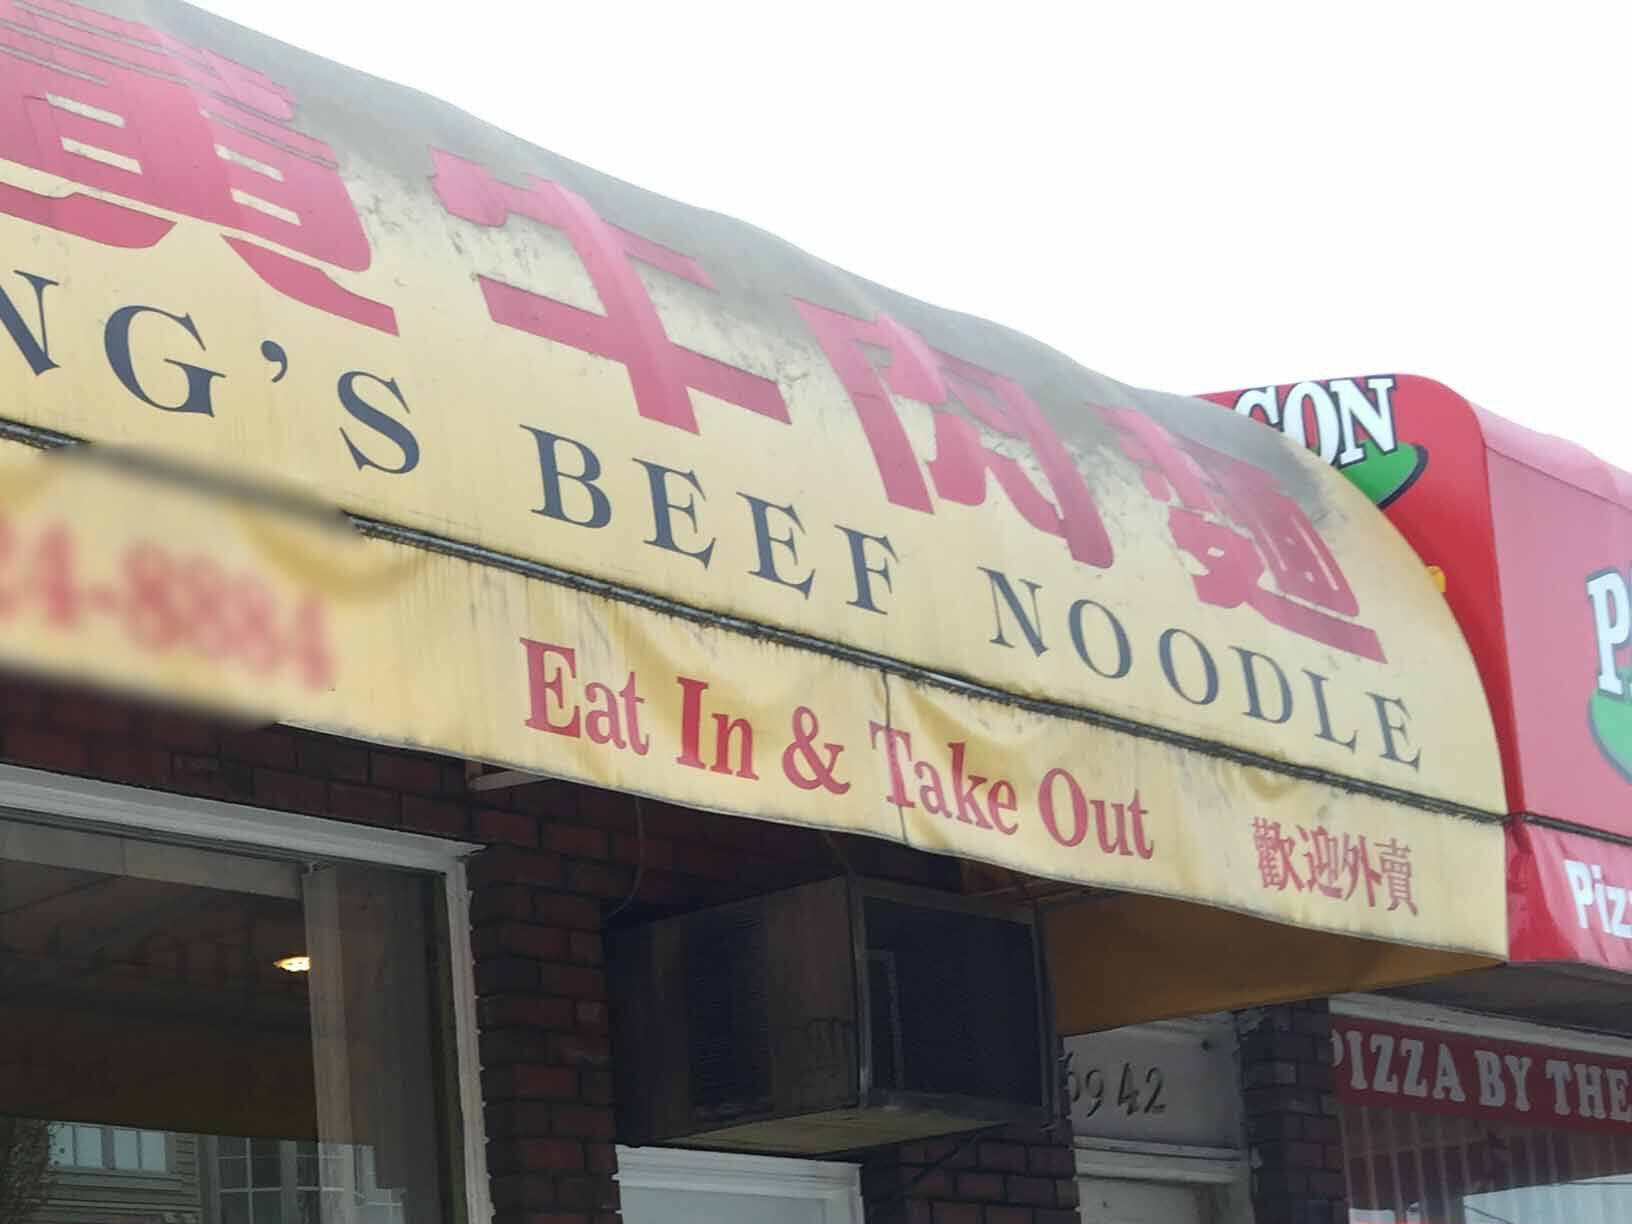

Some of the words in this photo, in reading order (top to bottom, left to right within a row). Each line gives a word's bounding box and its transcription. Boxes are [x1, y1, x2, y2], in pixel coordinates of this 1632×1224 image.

[519, 423, 900, 616] BEEF
[976, 565, 1423, 771] NOODLE
[519, 637, 651, 757] Eat
[675, 676, 760, 781] In
[781, 705, 851, 795] &
[870, 719, 1019, 836] Take
[1038, 767, 1155, 860] Out
[1252, 816, 1419, 917] 歡迎外賣
[1564, 860, 1632, 939] Piz
[1473, 1049, 1533, 1112] BY
[1544, 1059, 1632, 1123] THE
